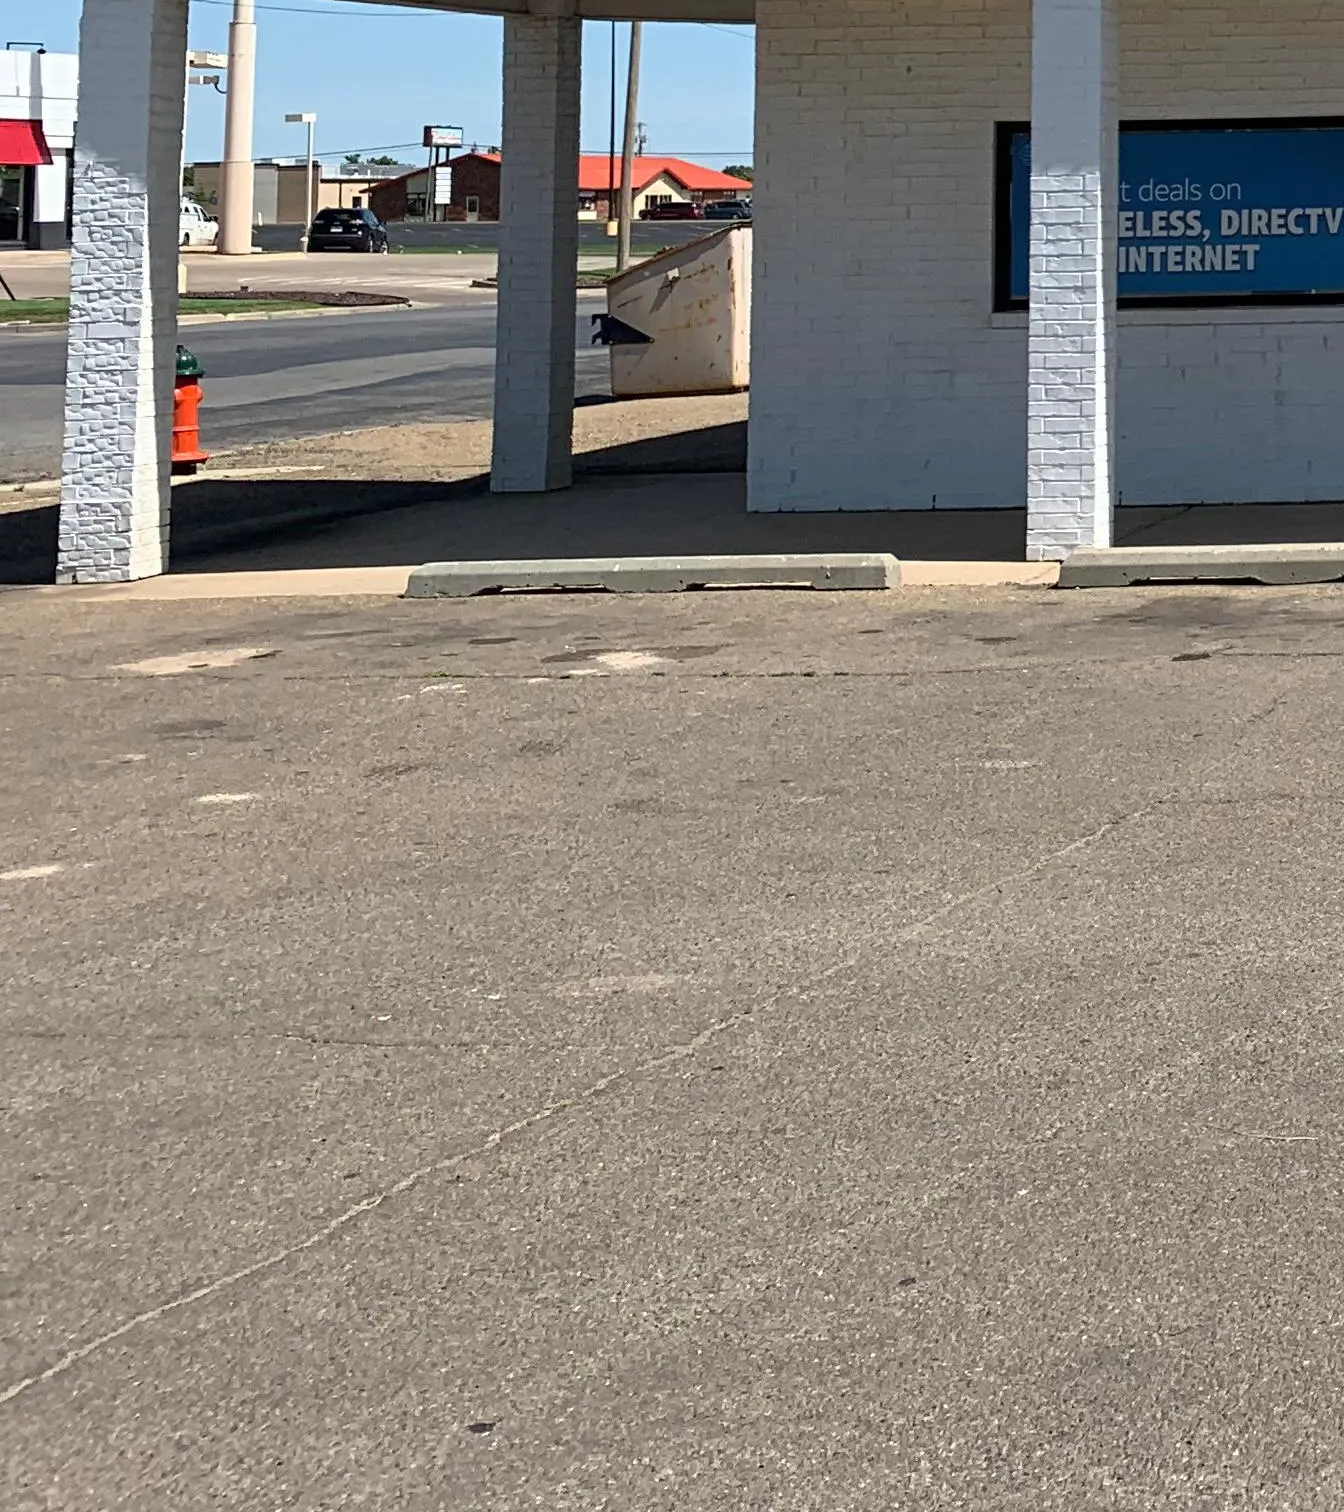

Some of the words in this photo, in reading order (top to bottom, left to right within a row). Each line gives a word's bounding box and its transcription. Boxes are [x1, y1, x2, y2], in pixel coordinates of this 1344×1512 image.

[1138, 177, 1202, 202] deals
[1209, 183, 1241, 200] on
[1119, 209, 1211, 242] ELESS,
[1220, 207, 1344, 236] DIRECTV
[1118, 244, 1260, 273] INTERNET
